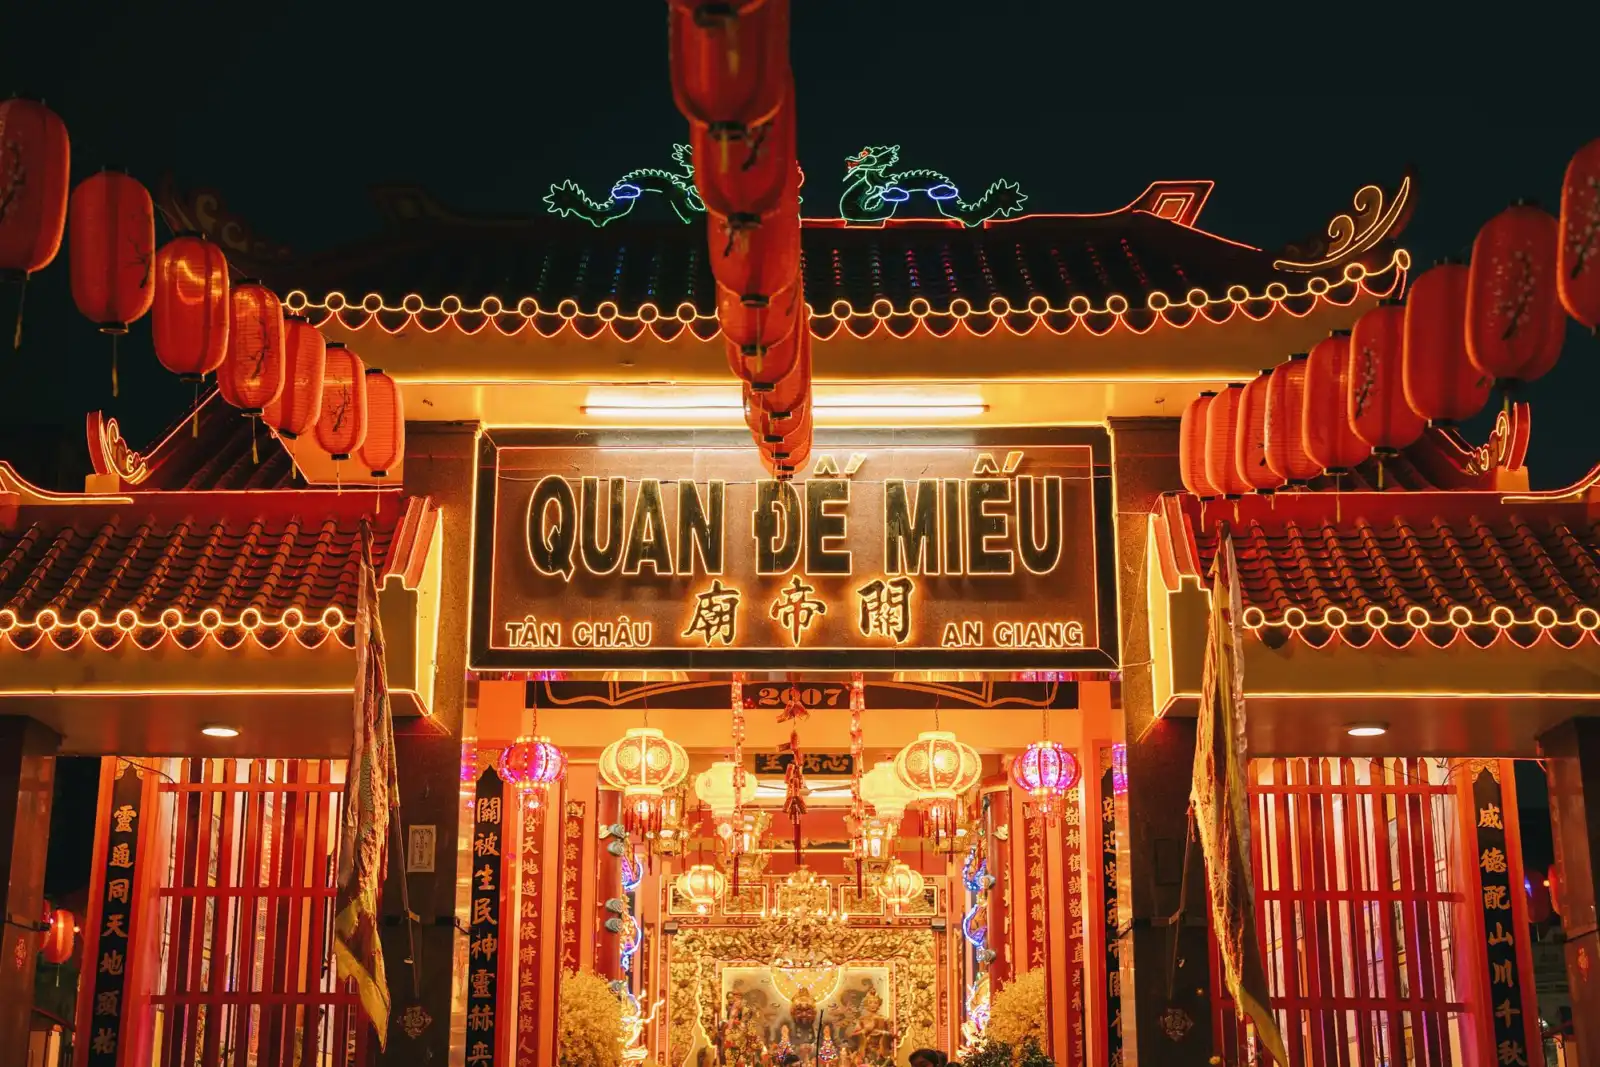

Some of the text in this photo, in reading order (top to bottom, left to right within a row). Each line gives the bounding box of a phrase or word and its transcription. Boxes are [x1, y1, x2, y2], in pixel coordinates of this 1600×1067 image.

[526, 451, 1062, 582] QUAN ĐẾ MIẾU
[505, 620, 653, 648] TÂN CHÂU
[941, 620, 1083, 648] AN GIANG
[758, 687, 843, 706] 2007
